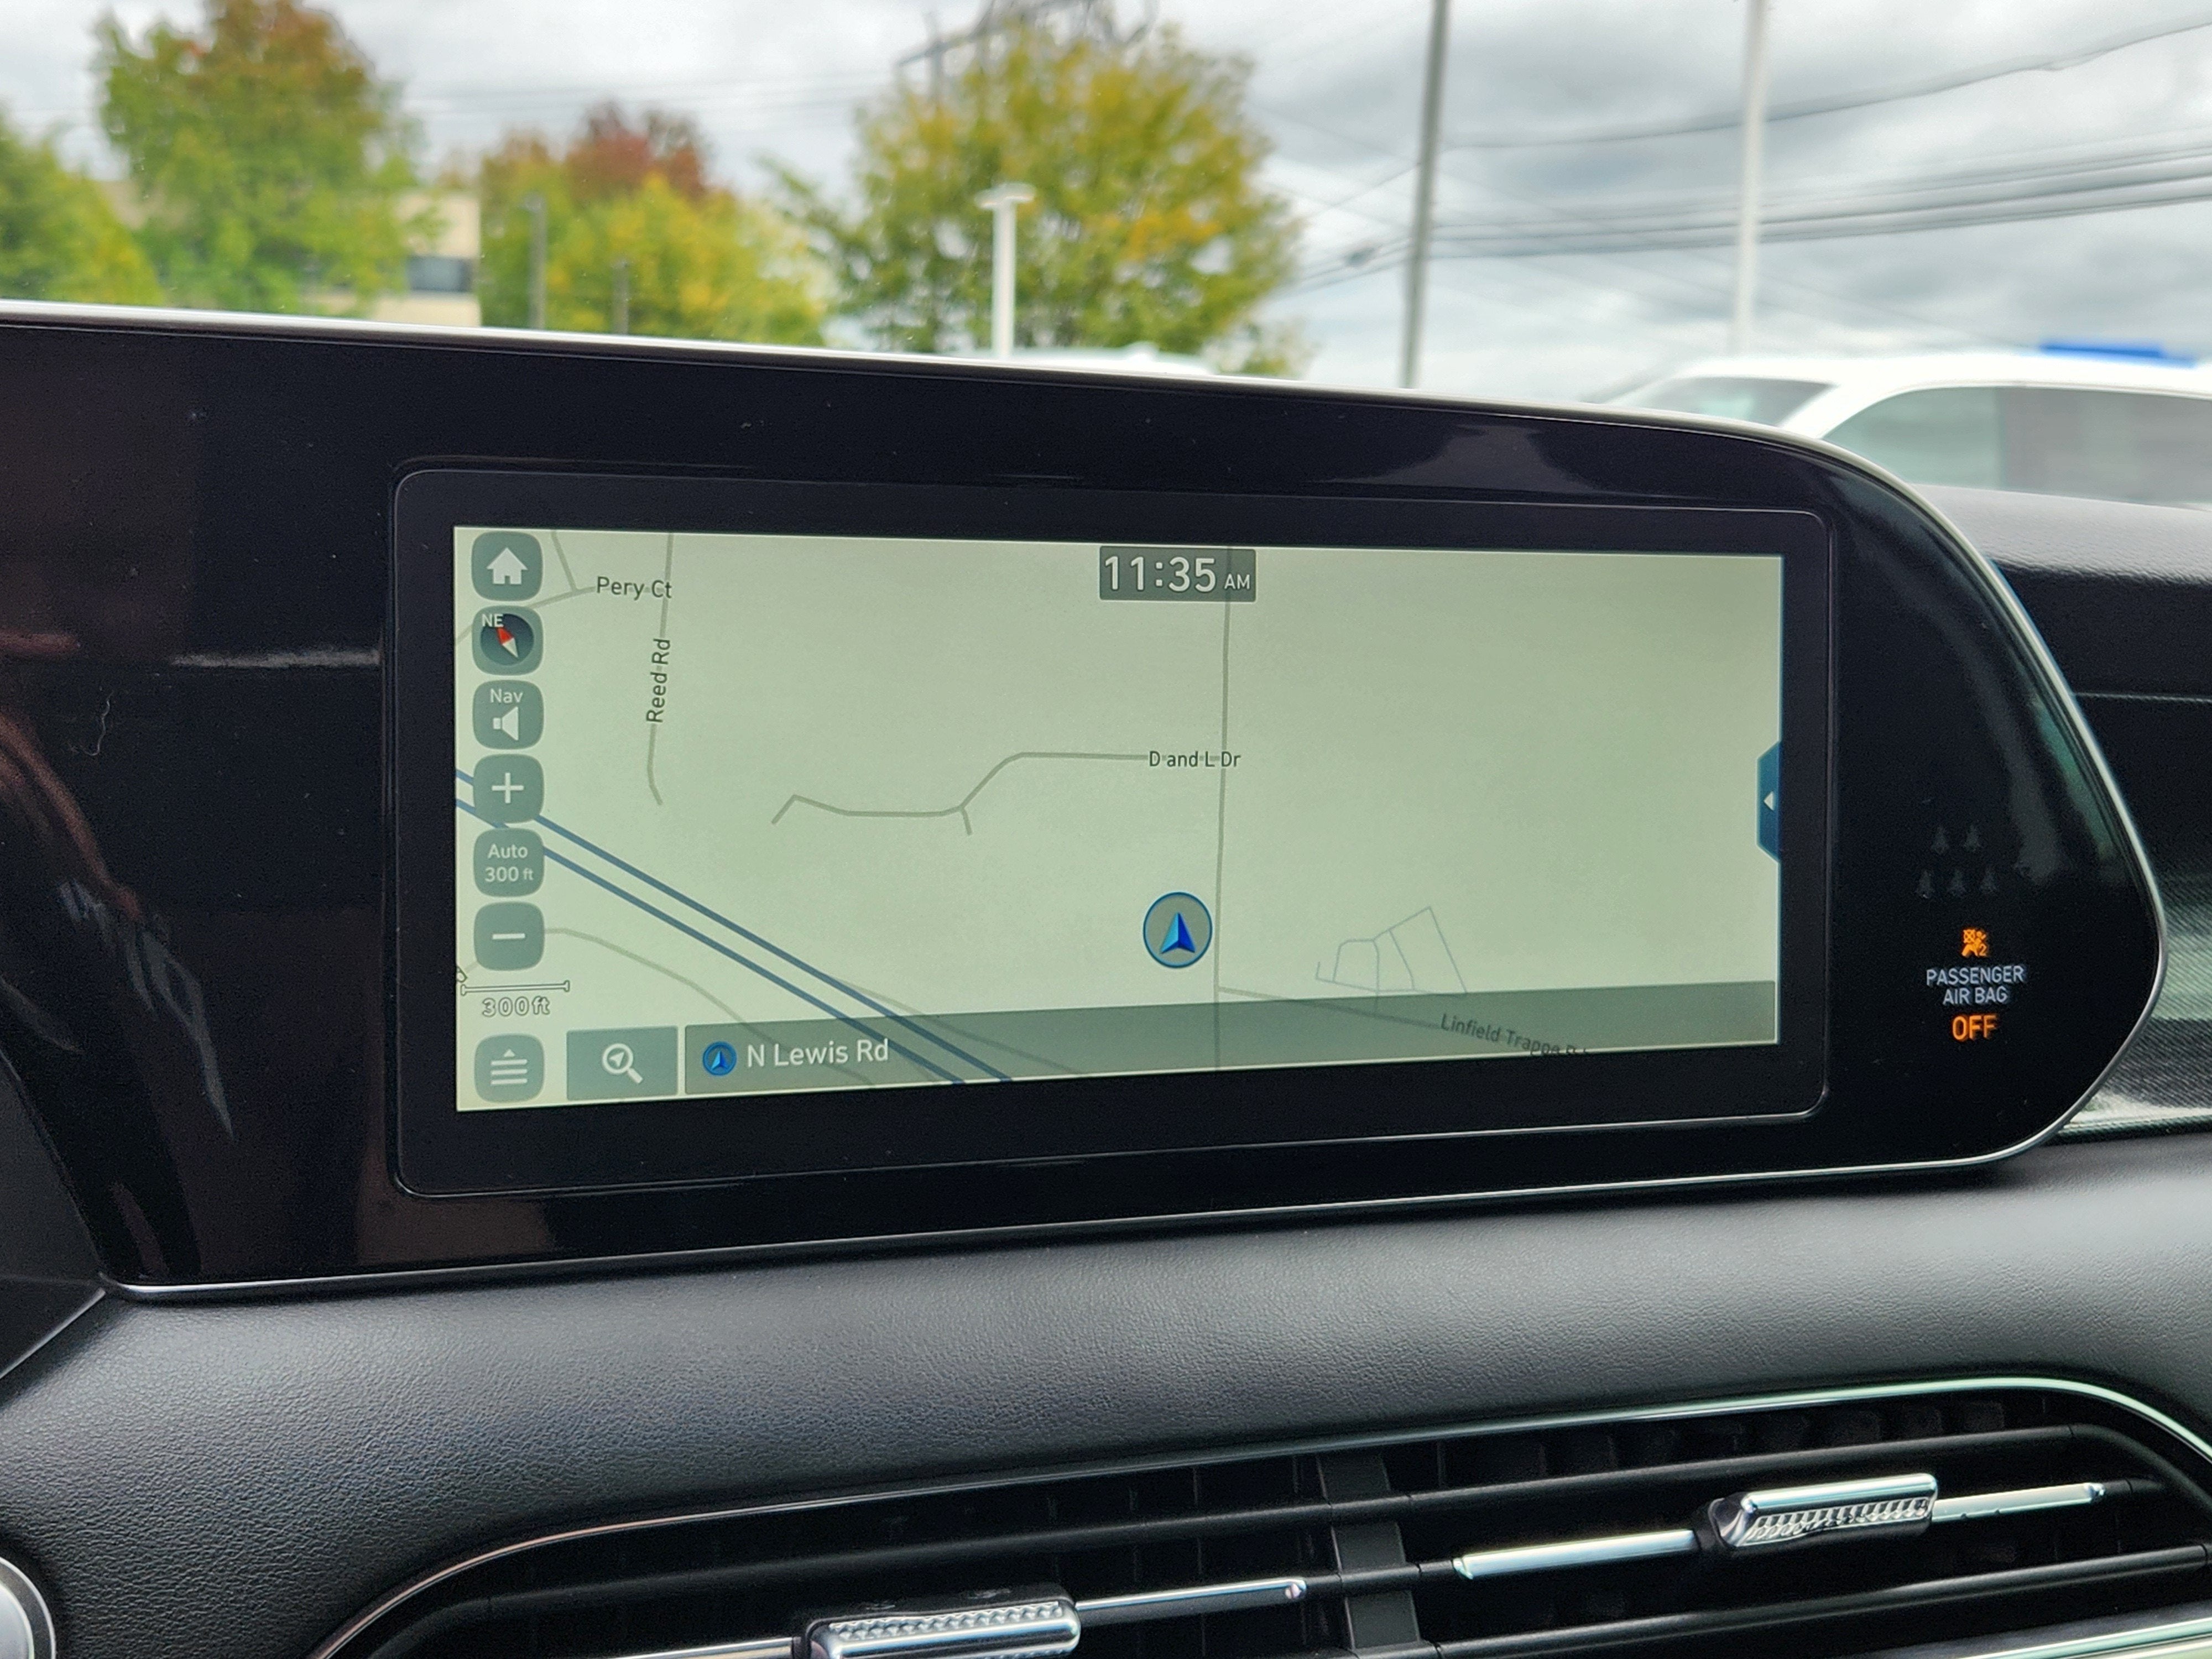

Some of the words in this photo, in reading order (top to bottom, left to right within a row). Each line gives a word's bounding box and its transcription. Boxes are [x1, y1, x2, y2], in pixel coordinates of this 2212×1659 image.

[1105, 556, 1216, 592] 11:35
[1224, 574, 1251, 589] AM
[597, 576, 645, 600] Pery
[651, 580, 672, 599] Ct
[481, 613, 504, 627] NE
[652, 638, 671, 665] Rd
[490, 688, 523, 704] Nav
[646, 671, 667, 723] Reed
[1149, 752, 1161, 767] D
[1166, 751, 1198, 768] and
[1205, 752, 1215, 767] L
[1221, 752, 1241, 767] Dr
[488, 844, 528, 859] Auto
[484, 867, 519, 882] 300
[523, 868, 534, 881] ft
[1926, 965, 2025, 986] PASSENGER
[1942, 988, 1971, 1005] AIR
[1975, 985, 2008, 1004] BAG
[1440, 1013, 1501, 1042] Linfield
[1952, 1014, 1997, 1041] OFF
[748, 1044, 765, 1068] N
[774, 1040, 848, 1066] Lewis
[857, 1037, 888, 1062] Rd
